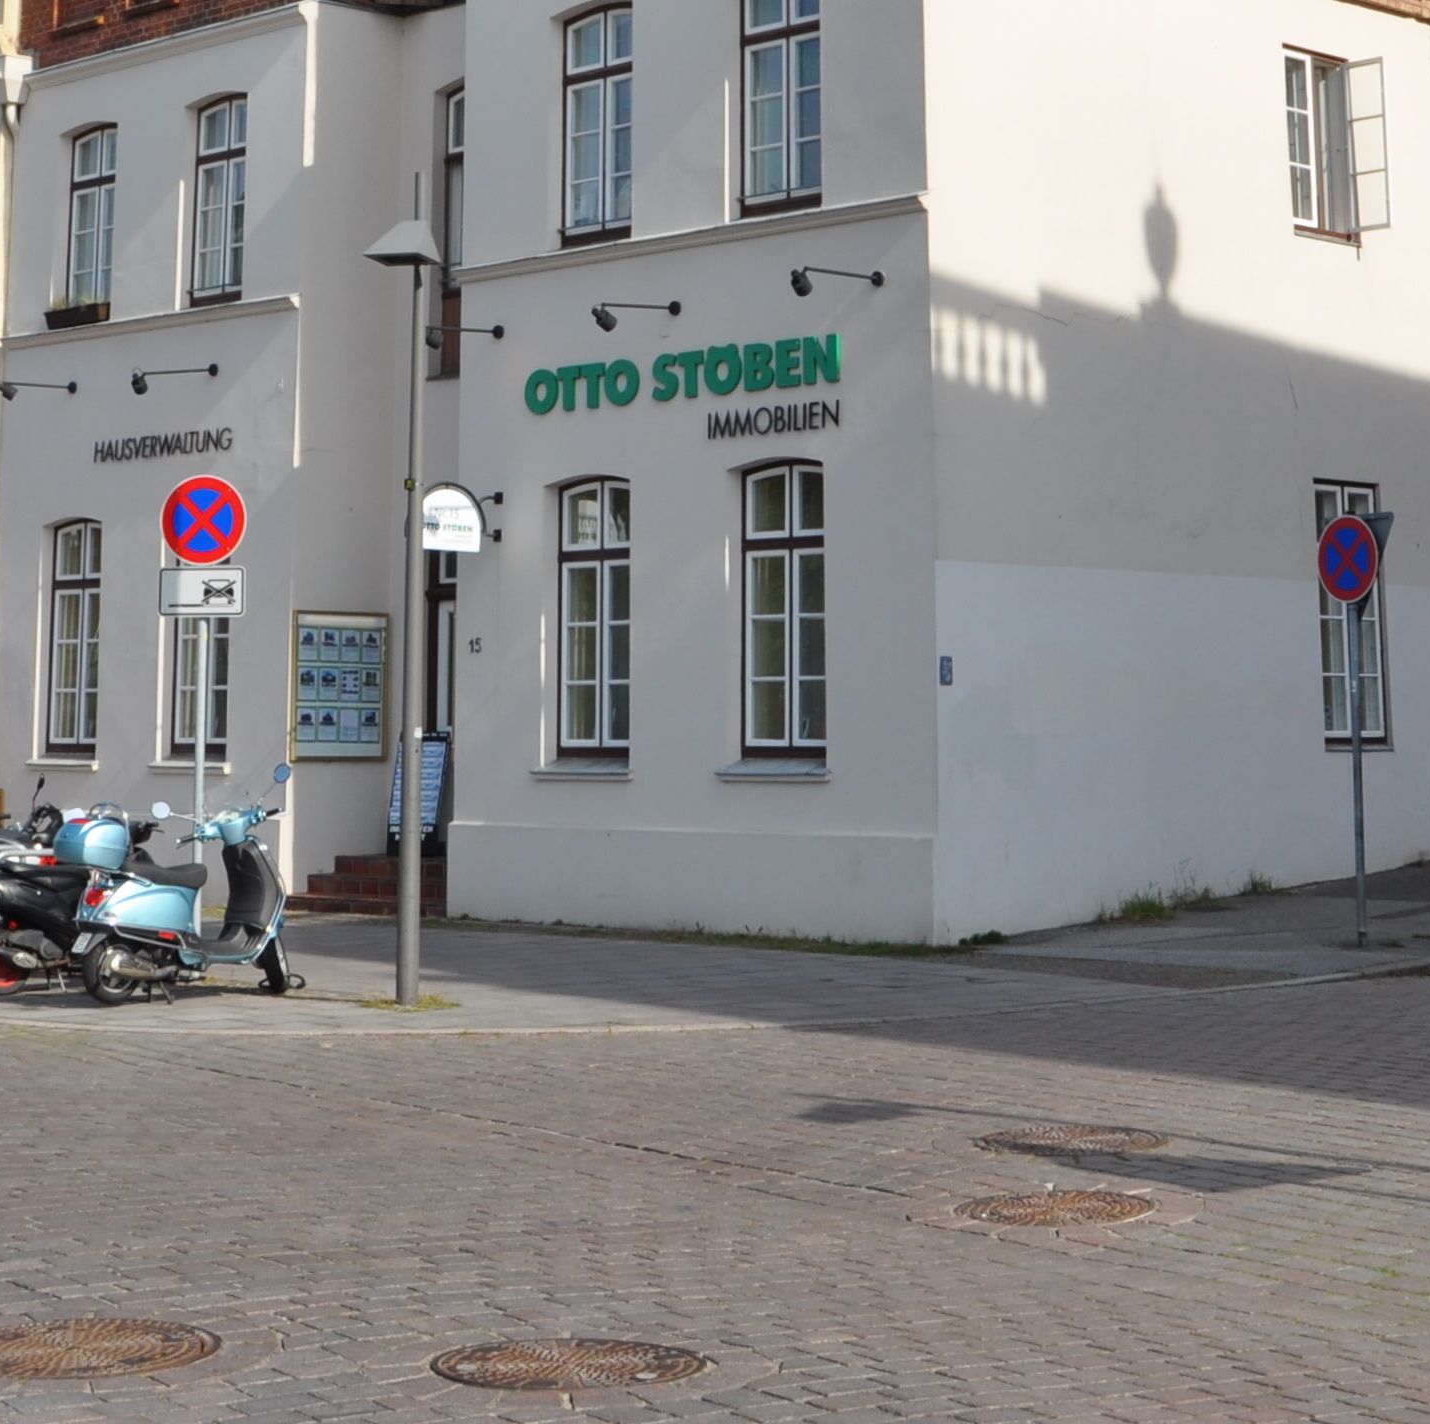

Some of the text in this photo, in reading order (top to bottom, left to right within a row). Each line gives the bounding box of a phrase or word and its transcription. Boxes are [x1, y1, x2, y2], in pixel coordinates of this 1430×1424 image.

[524, 333, 841, 415] OTTO STÖBEN
[707, 400, 840, 440] IMMOBILIEN
[94, 427, 233, 463] HAUSVERWALTUNG
[423, 522, 440, 530] TTO
[468, 637, 482, 654] 15
